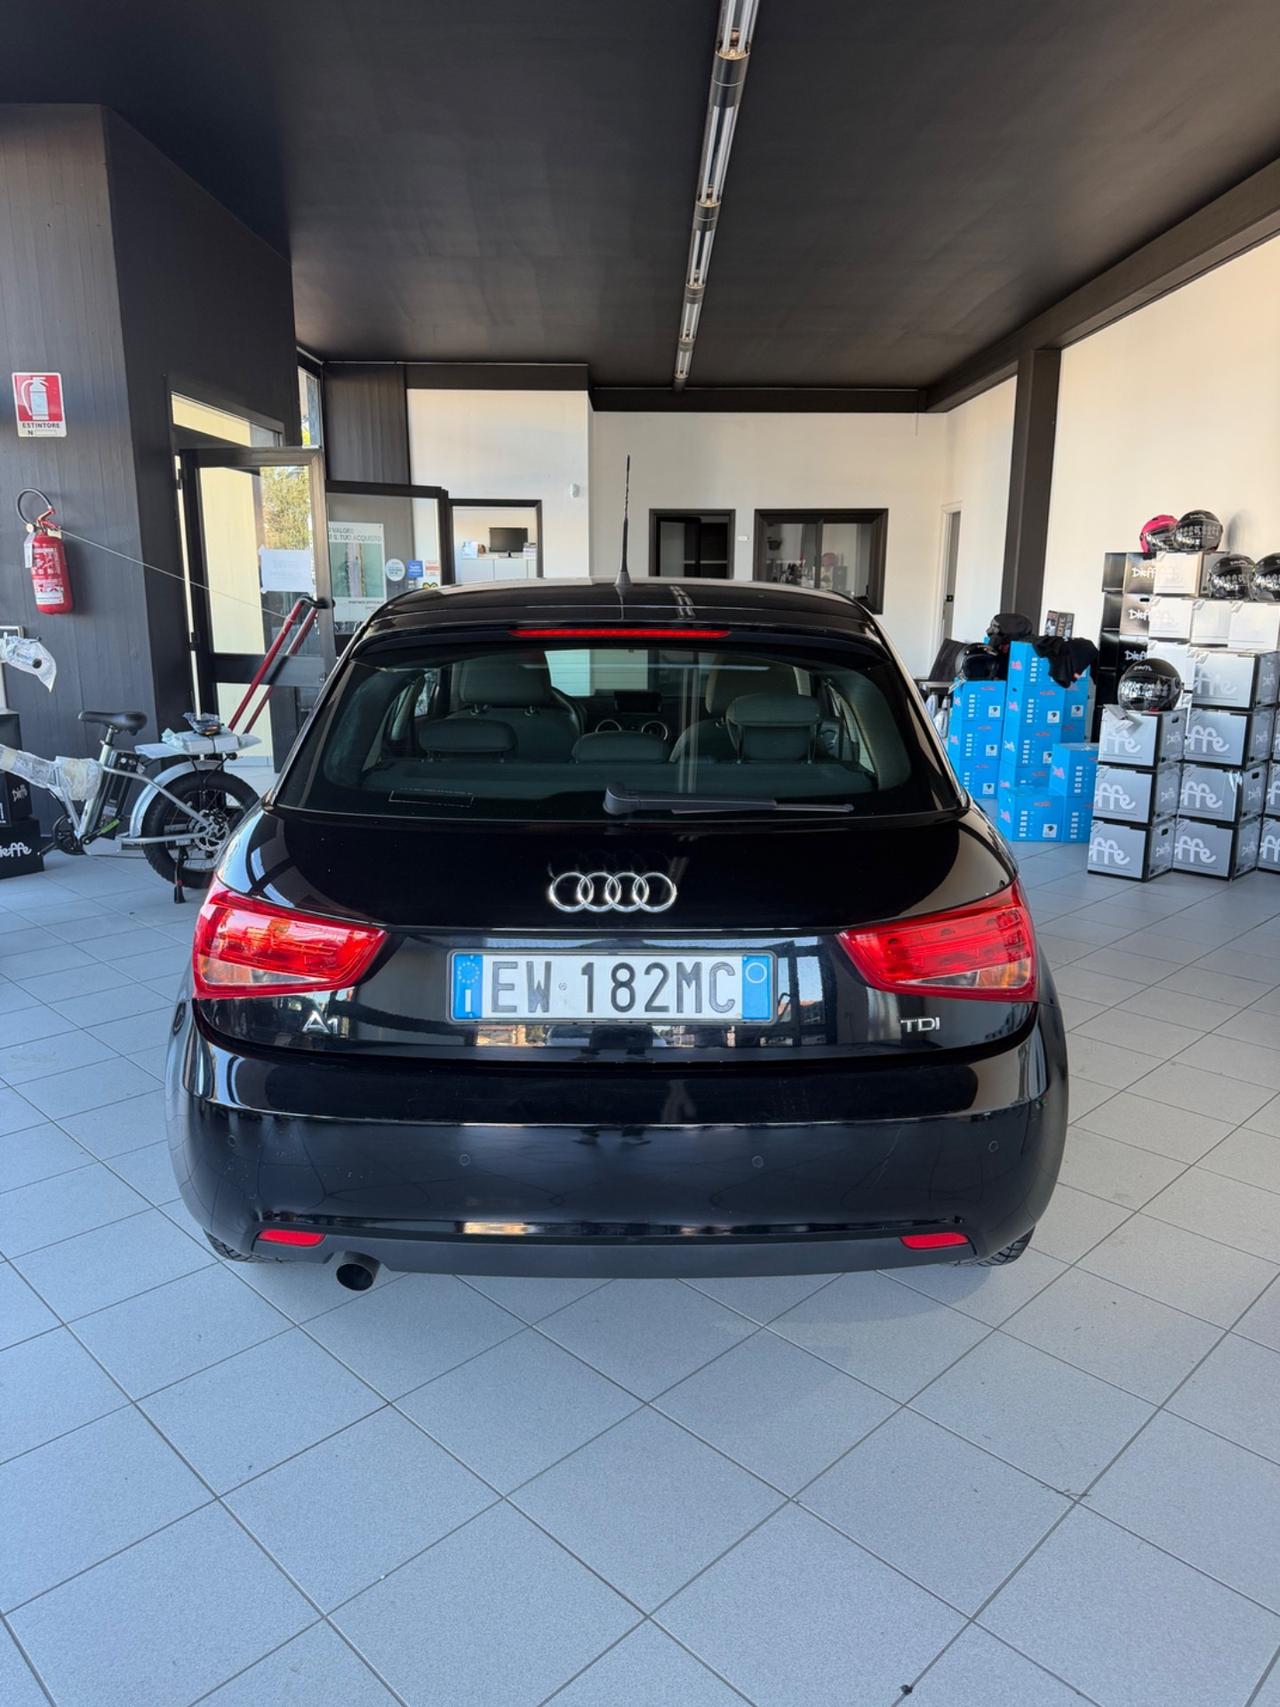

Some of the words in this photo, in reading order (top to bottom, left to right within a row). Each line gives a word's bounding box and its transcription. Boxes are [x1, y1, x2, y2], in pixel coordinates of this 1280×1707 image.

[491, 960, 552, 1013] EW
[581, 960, 736, 1014] 182MC
[302, 1010, 338, 1034] A1
[900, 1016, 940, 1033] TDI
